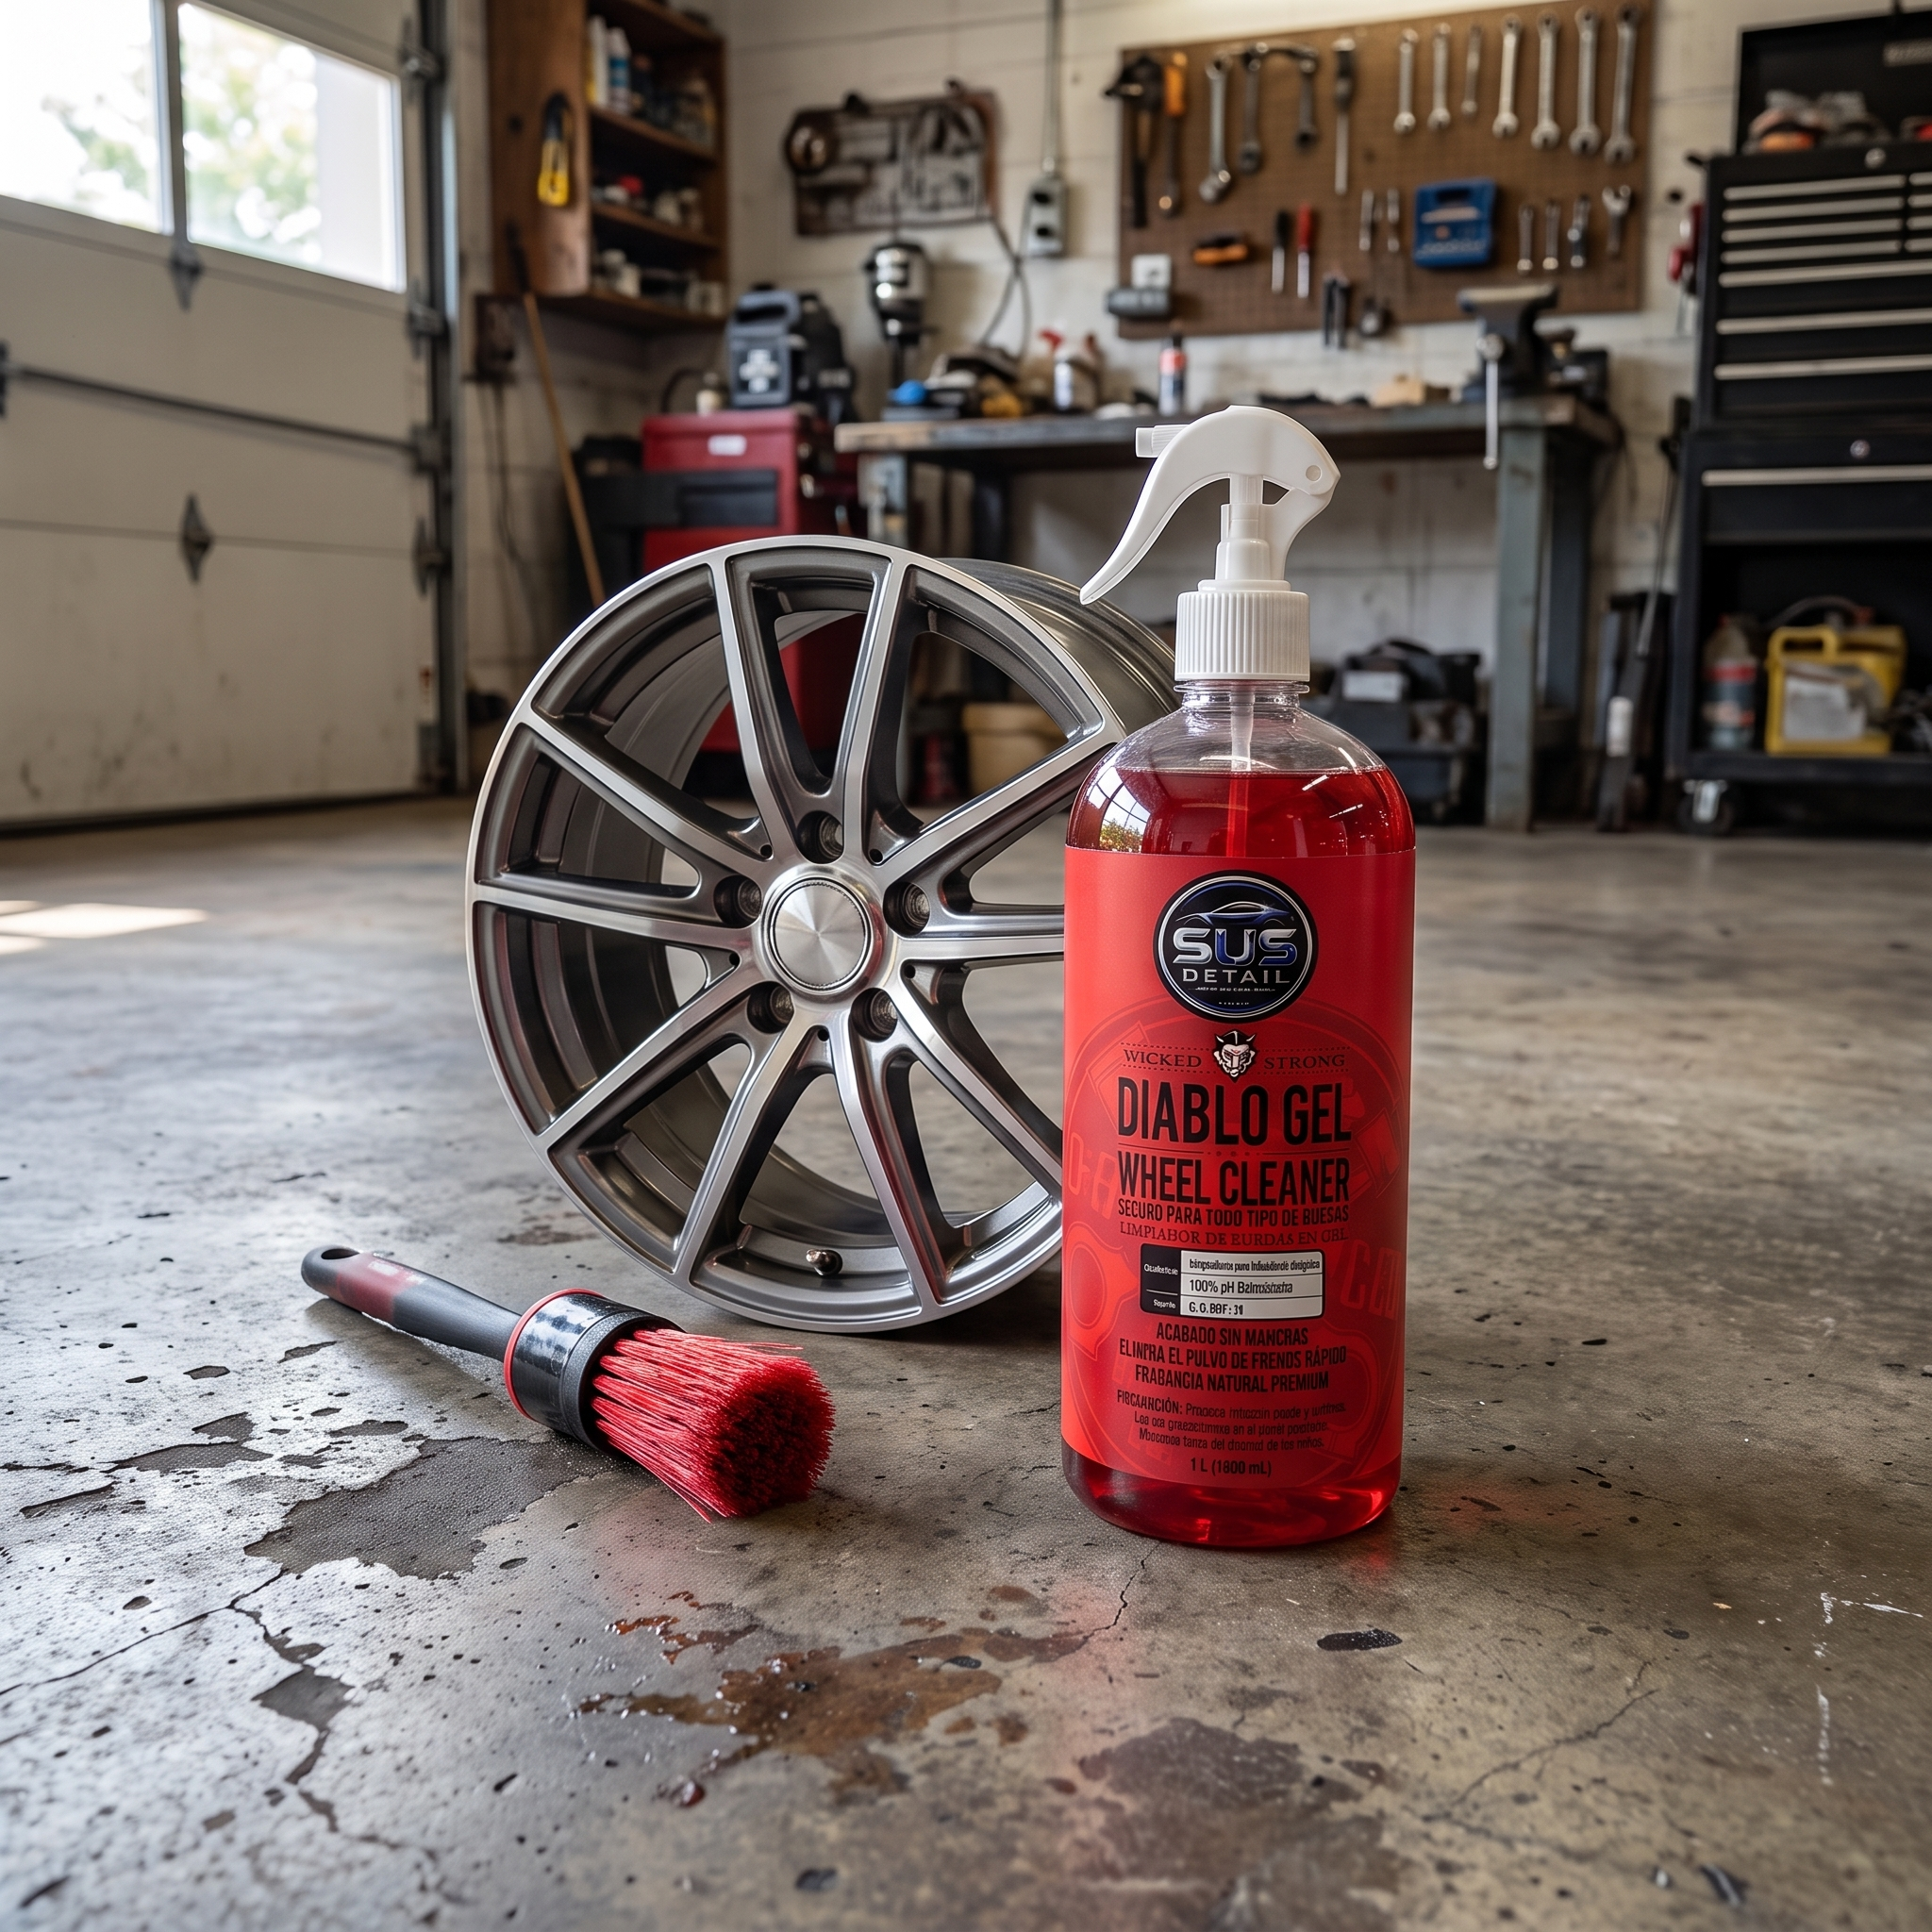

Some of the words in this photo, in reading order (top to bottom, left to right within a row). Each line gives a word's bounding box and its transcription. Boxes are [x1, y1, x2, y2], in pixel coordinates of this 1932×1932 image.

[1173, 927, 1298, 967] SUS
[1182, 968, 1291, 984] DETAIL
[1124, 1049, 1202, 1068] WICKED
[1263, 1054, 1345, 1070] STRONG
[1118, 1076, 1269, 1146] DIABLO
[1283, 1082, 1352, 1146] GEL
[1118, 1150, 1211, 1205] WHEEL
[1219, 1157, 1350, 1207] CLEANER
[1166, 1205, 1203, 1225] PARA
[1206, 1208, 1242, 1227] TODO
[1247, 1208, 1278, 1227] TIPO
[1281, 1208, 1299, 1226] DE
[1303, 1204, 1349, 1225] BUESAS
[1205, 1232, 1226, 1245] DE
[1298, 1230, 1318, 1244] EN
[1190, 1279, 1219, 1293] 100%
[1221, 1281, 1235, 1295] pH
[1157, 1322, 1216, 1345] ACABADO
[1219, 1327, 1241, 1346] SIN
[1169, 1346, 1184, 1366] EL
[1186, 1348, 1228, 1370] PULVO
[1231, 1351, 1249, 1370] DE
[1305, 1344, 1347, 1368] RÁPIDO
[1207, 1373, 1269, 1393] NATURAL
[1271, 1370, 1329, 1393] PREMIUM
[1191, 1457, 1196, 1472] 1
[1200, 1457, 1208, 1473] L
[1248, 1459, 1273, 1478] mL)
